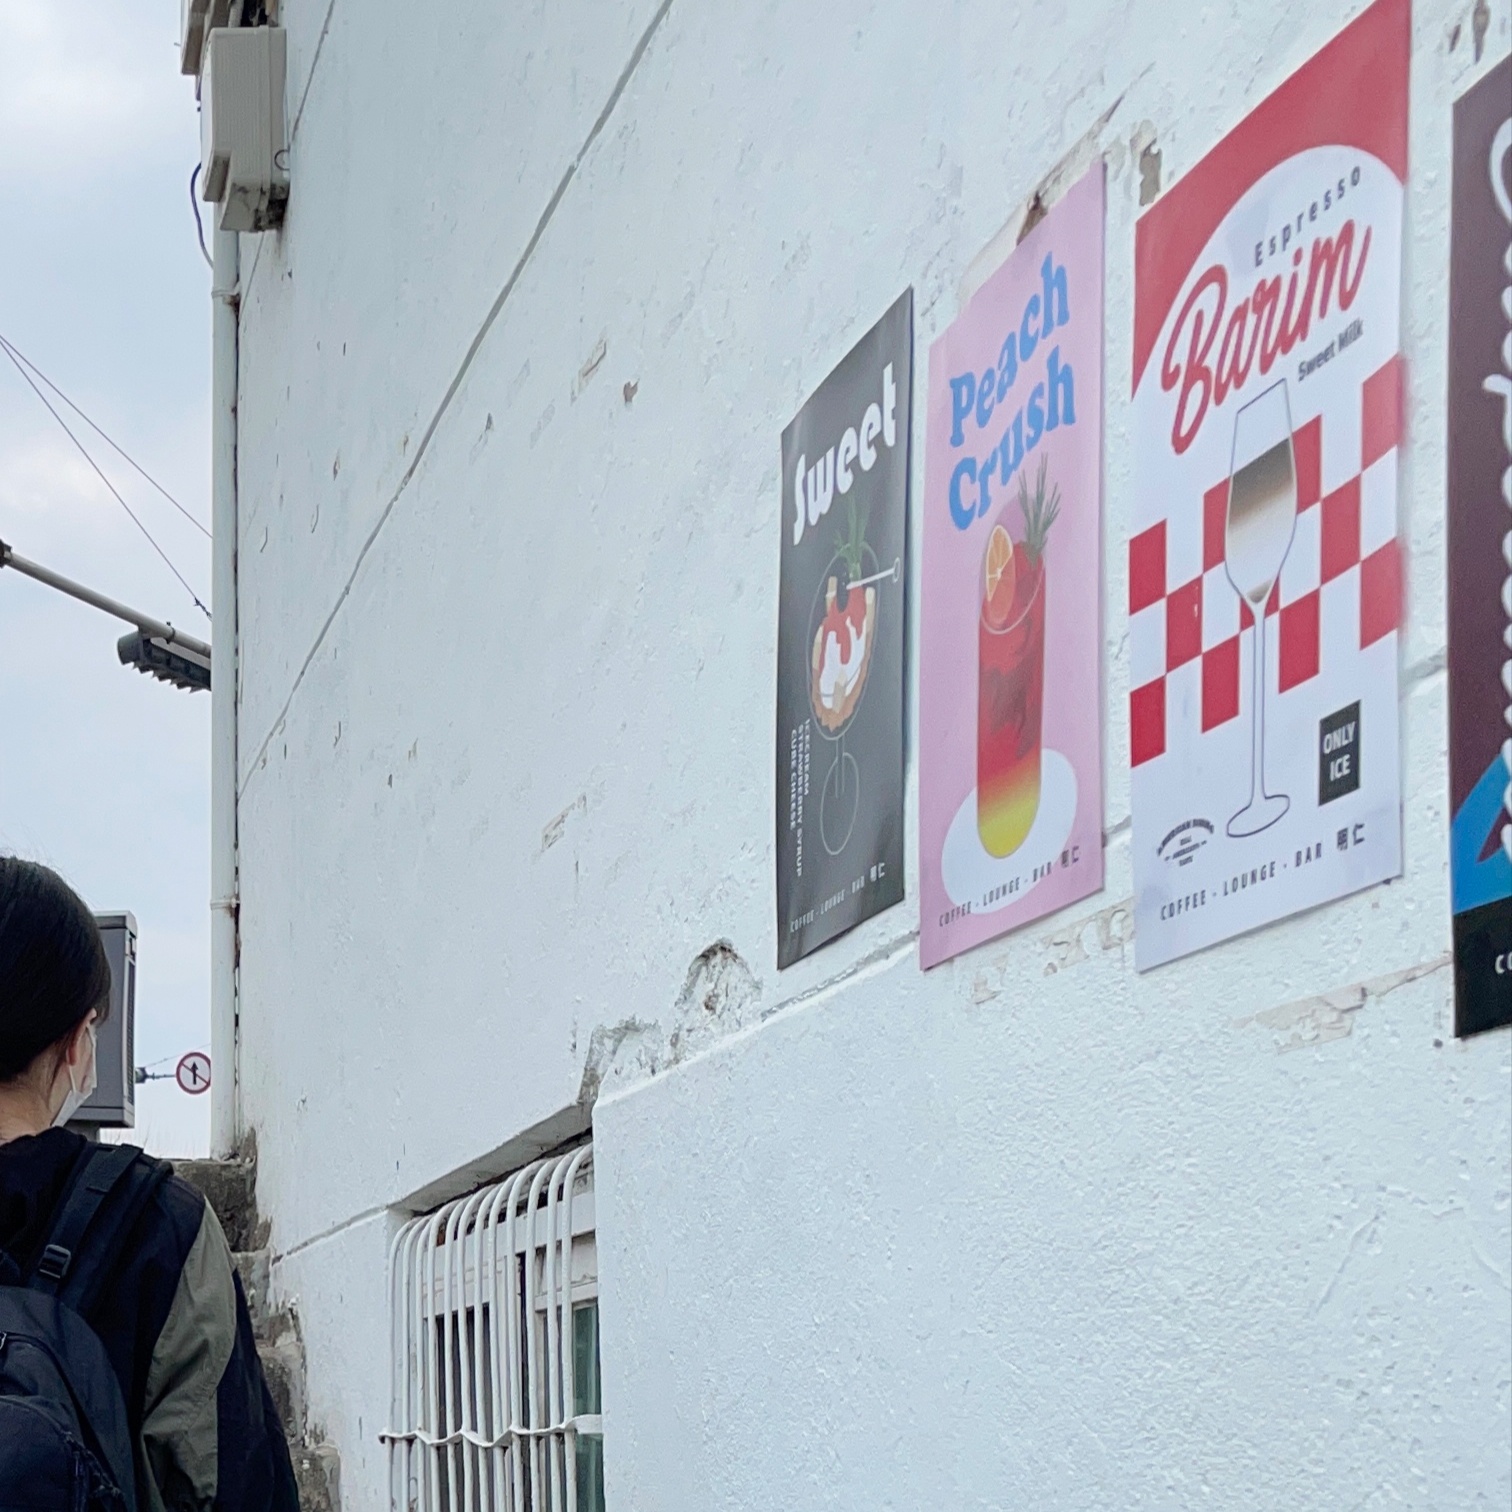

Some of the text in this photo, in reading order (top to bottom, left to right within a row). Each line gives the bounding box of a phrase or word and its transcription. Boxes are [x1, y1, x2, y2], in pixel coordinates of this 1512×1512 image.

[1254, 166, 1361, 269] Espresso
[949, 251, 1071, 449] Peach
[1161, 218, 1373, 457] Barim
[1298, 340, 1336, 383] Sweet
[949, 344, 1077, 532] Crush
[1323, 721, 1356, 754] ONLY
[1329, 754, 1351, 781] ICE
[1160, 842, 1322, 921] COFFEE LOUNGE BAR
